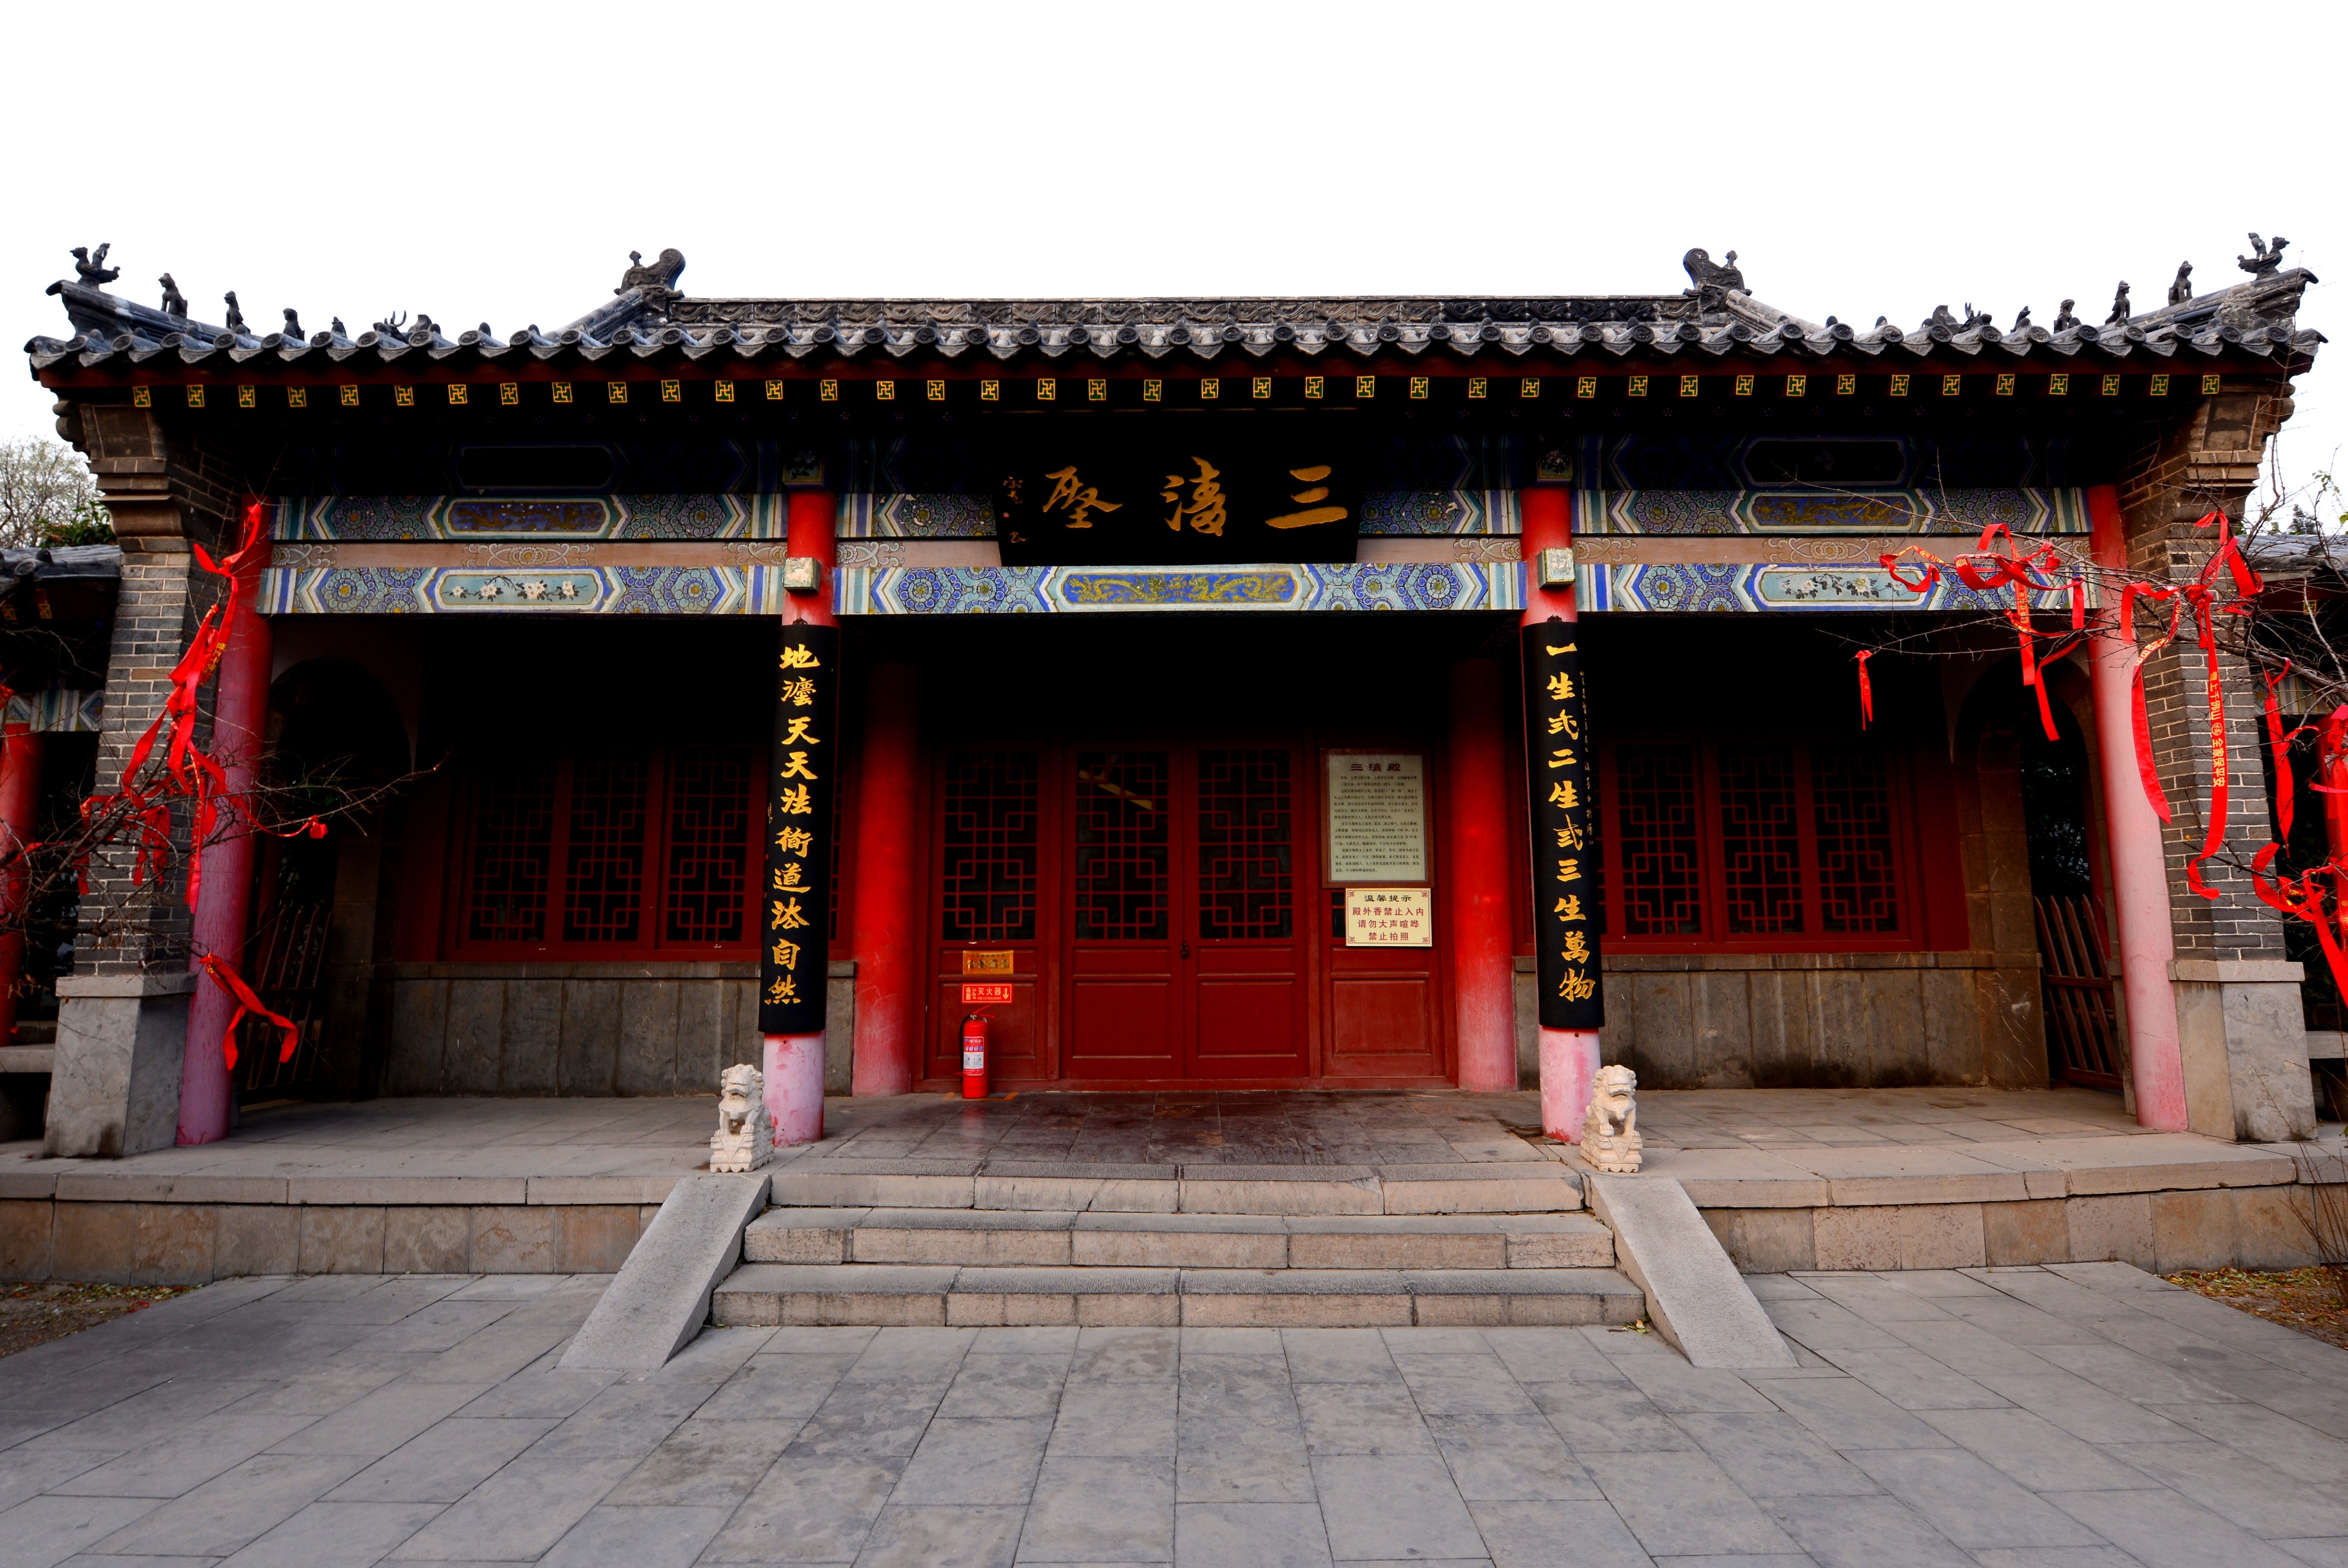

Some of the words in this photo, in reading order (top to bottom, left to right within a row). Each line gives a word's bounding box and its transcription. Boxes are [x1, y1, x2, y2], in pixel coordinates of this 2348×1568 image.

[1350, 763, 1401, 772] 三清殿
[1364, 894, 1412, 903] 温馨提示
[1352, 907, 1424, 916] 殿外香禁止入内
[1358, 920, 1419, 929] 请勿大声喧哗
[1368, 932, 1409, 941] 禁止拍照
[977, 987, 1001, 996] 灭火器
